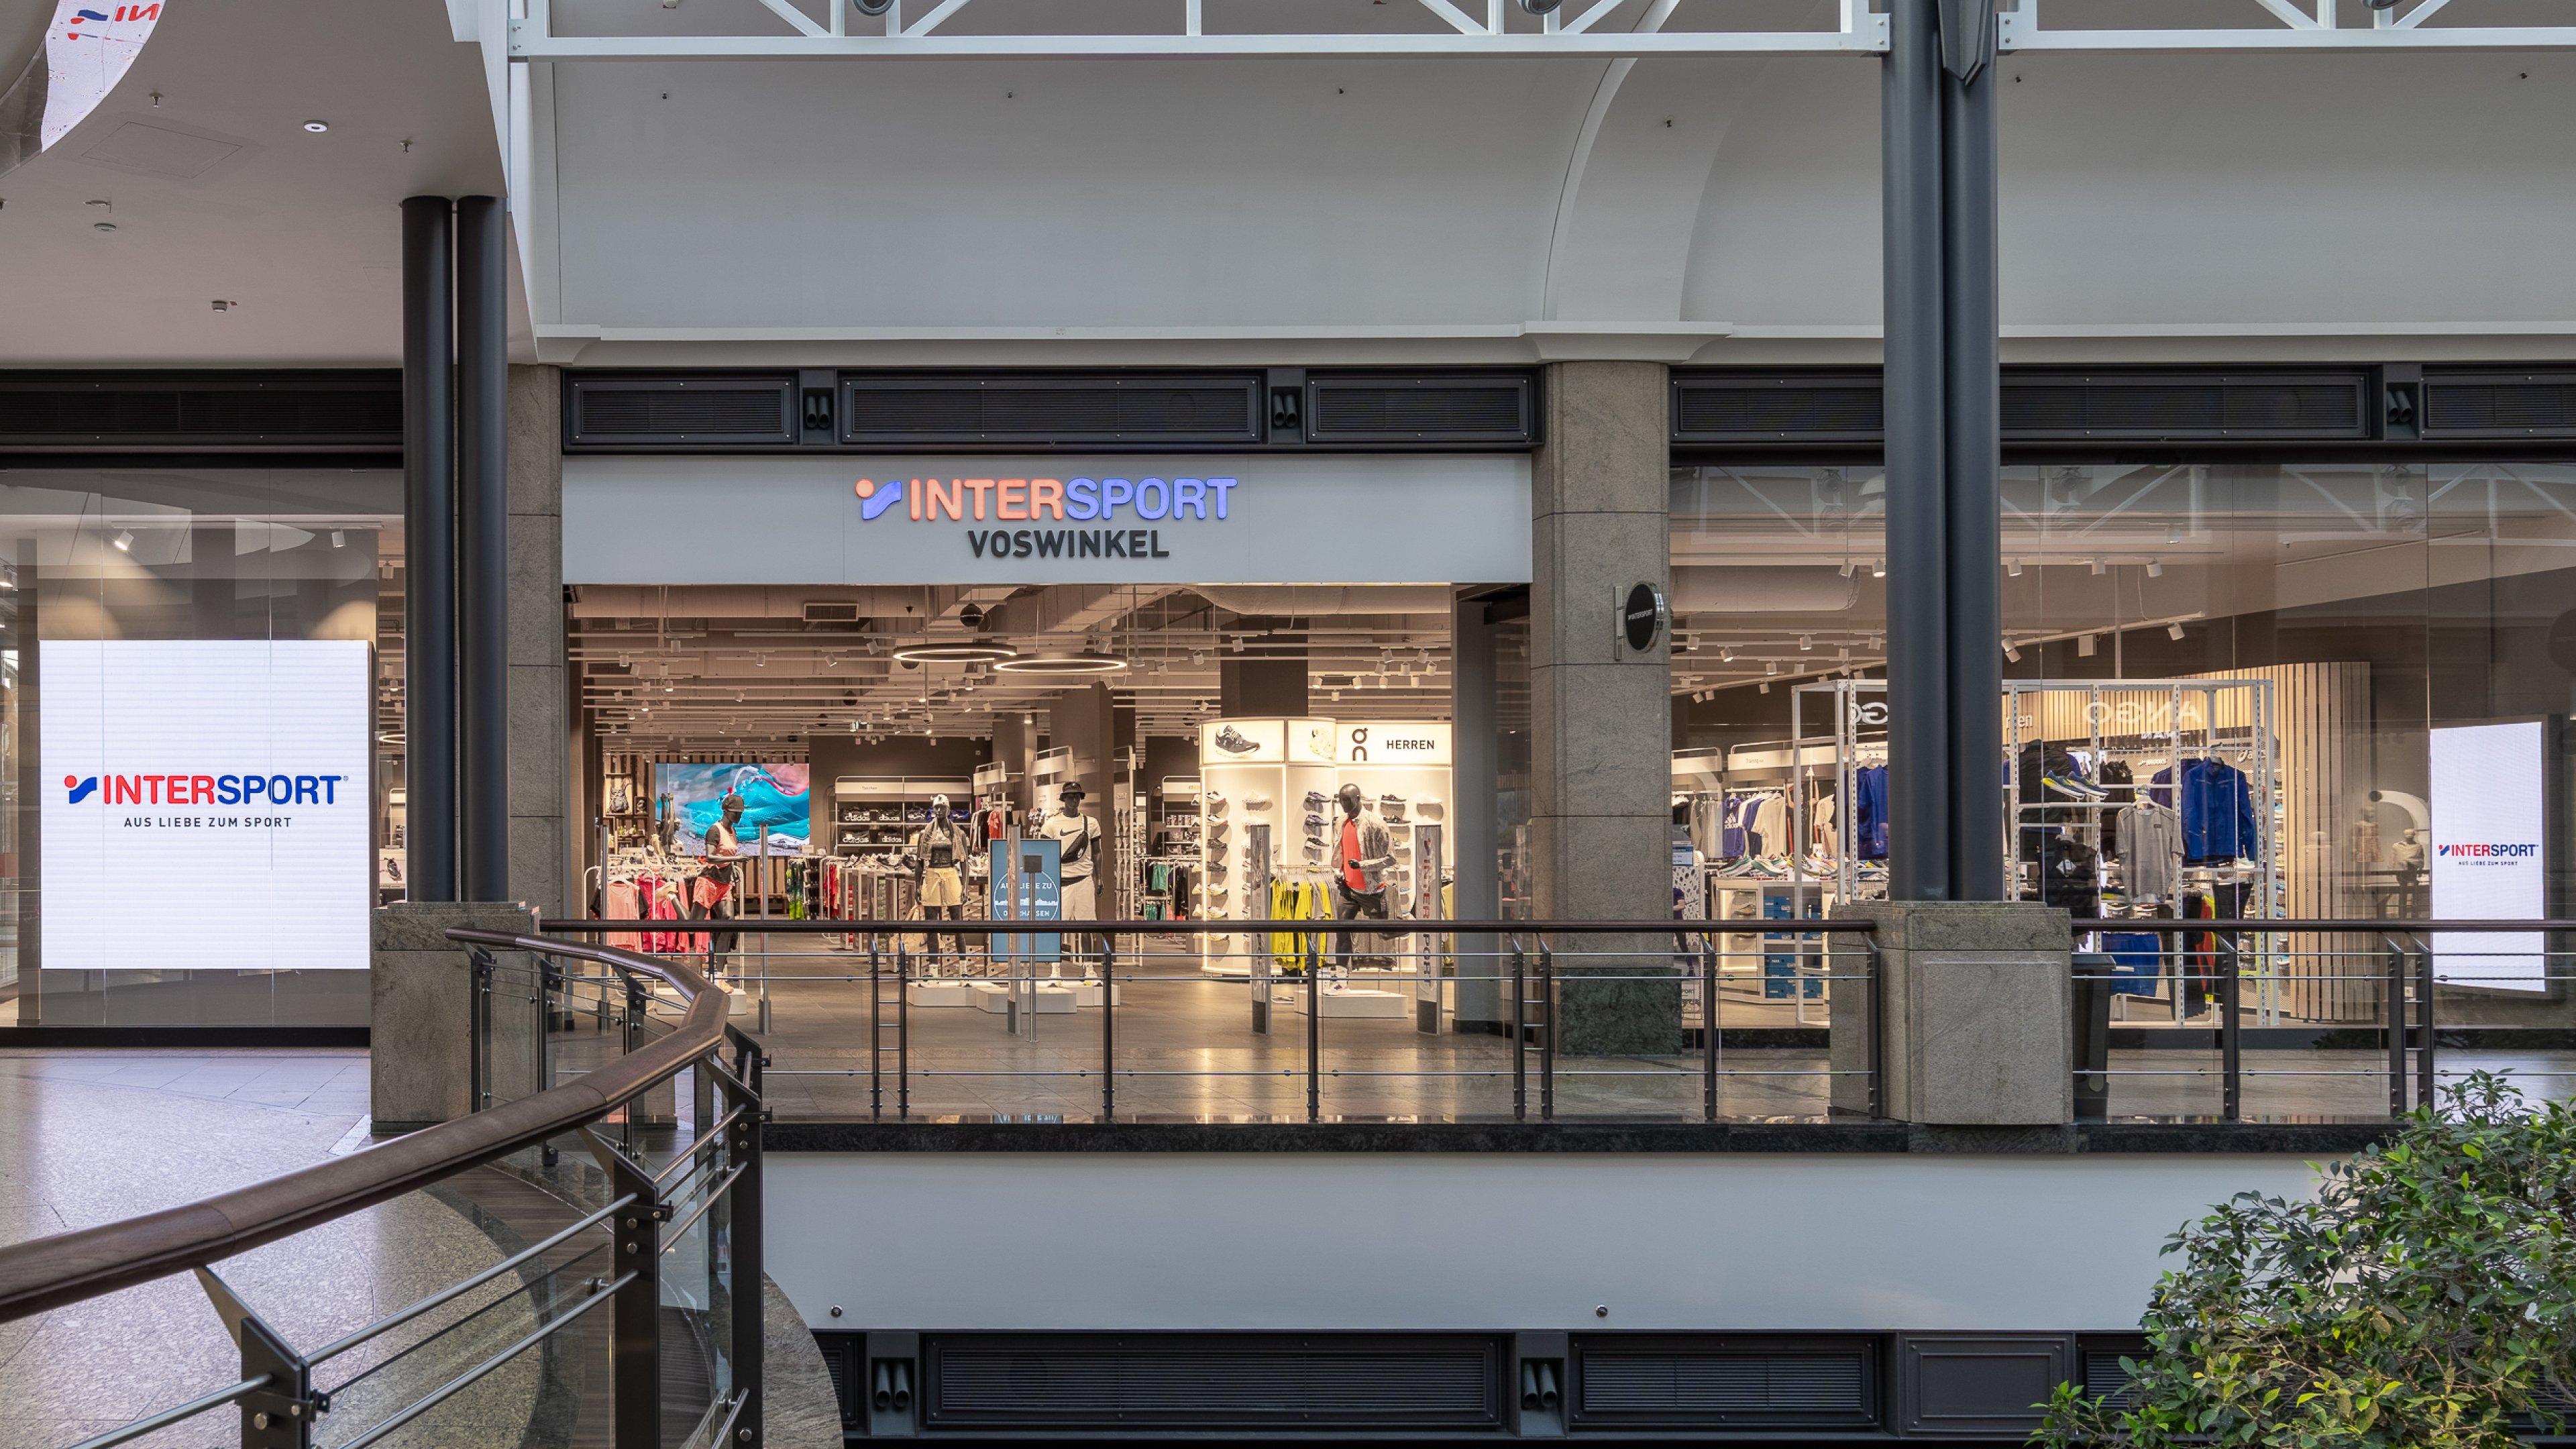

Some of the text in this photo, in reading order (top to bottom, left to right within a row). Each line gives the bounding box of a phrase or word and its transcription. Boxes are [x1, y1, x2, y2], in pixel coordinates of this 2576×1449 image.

[909, 476, 1238, 521] INTERSPORT
[967, 529, 1170, 558] VOSWINKEL
[1386, 740, 1435, 750] HERREN
[124, 817, 291, 827] AUS LIEBE ZUM SPORT
[2451, 844, 2536, 857] INTERSPORT
[1423, 859, 1431, 986] INTERPORT
